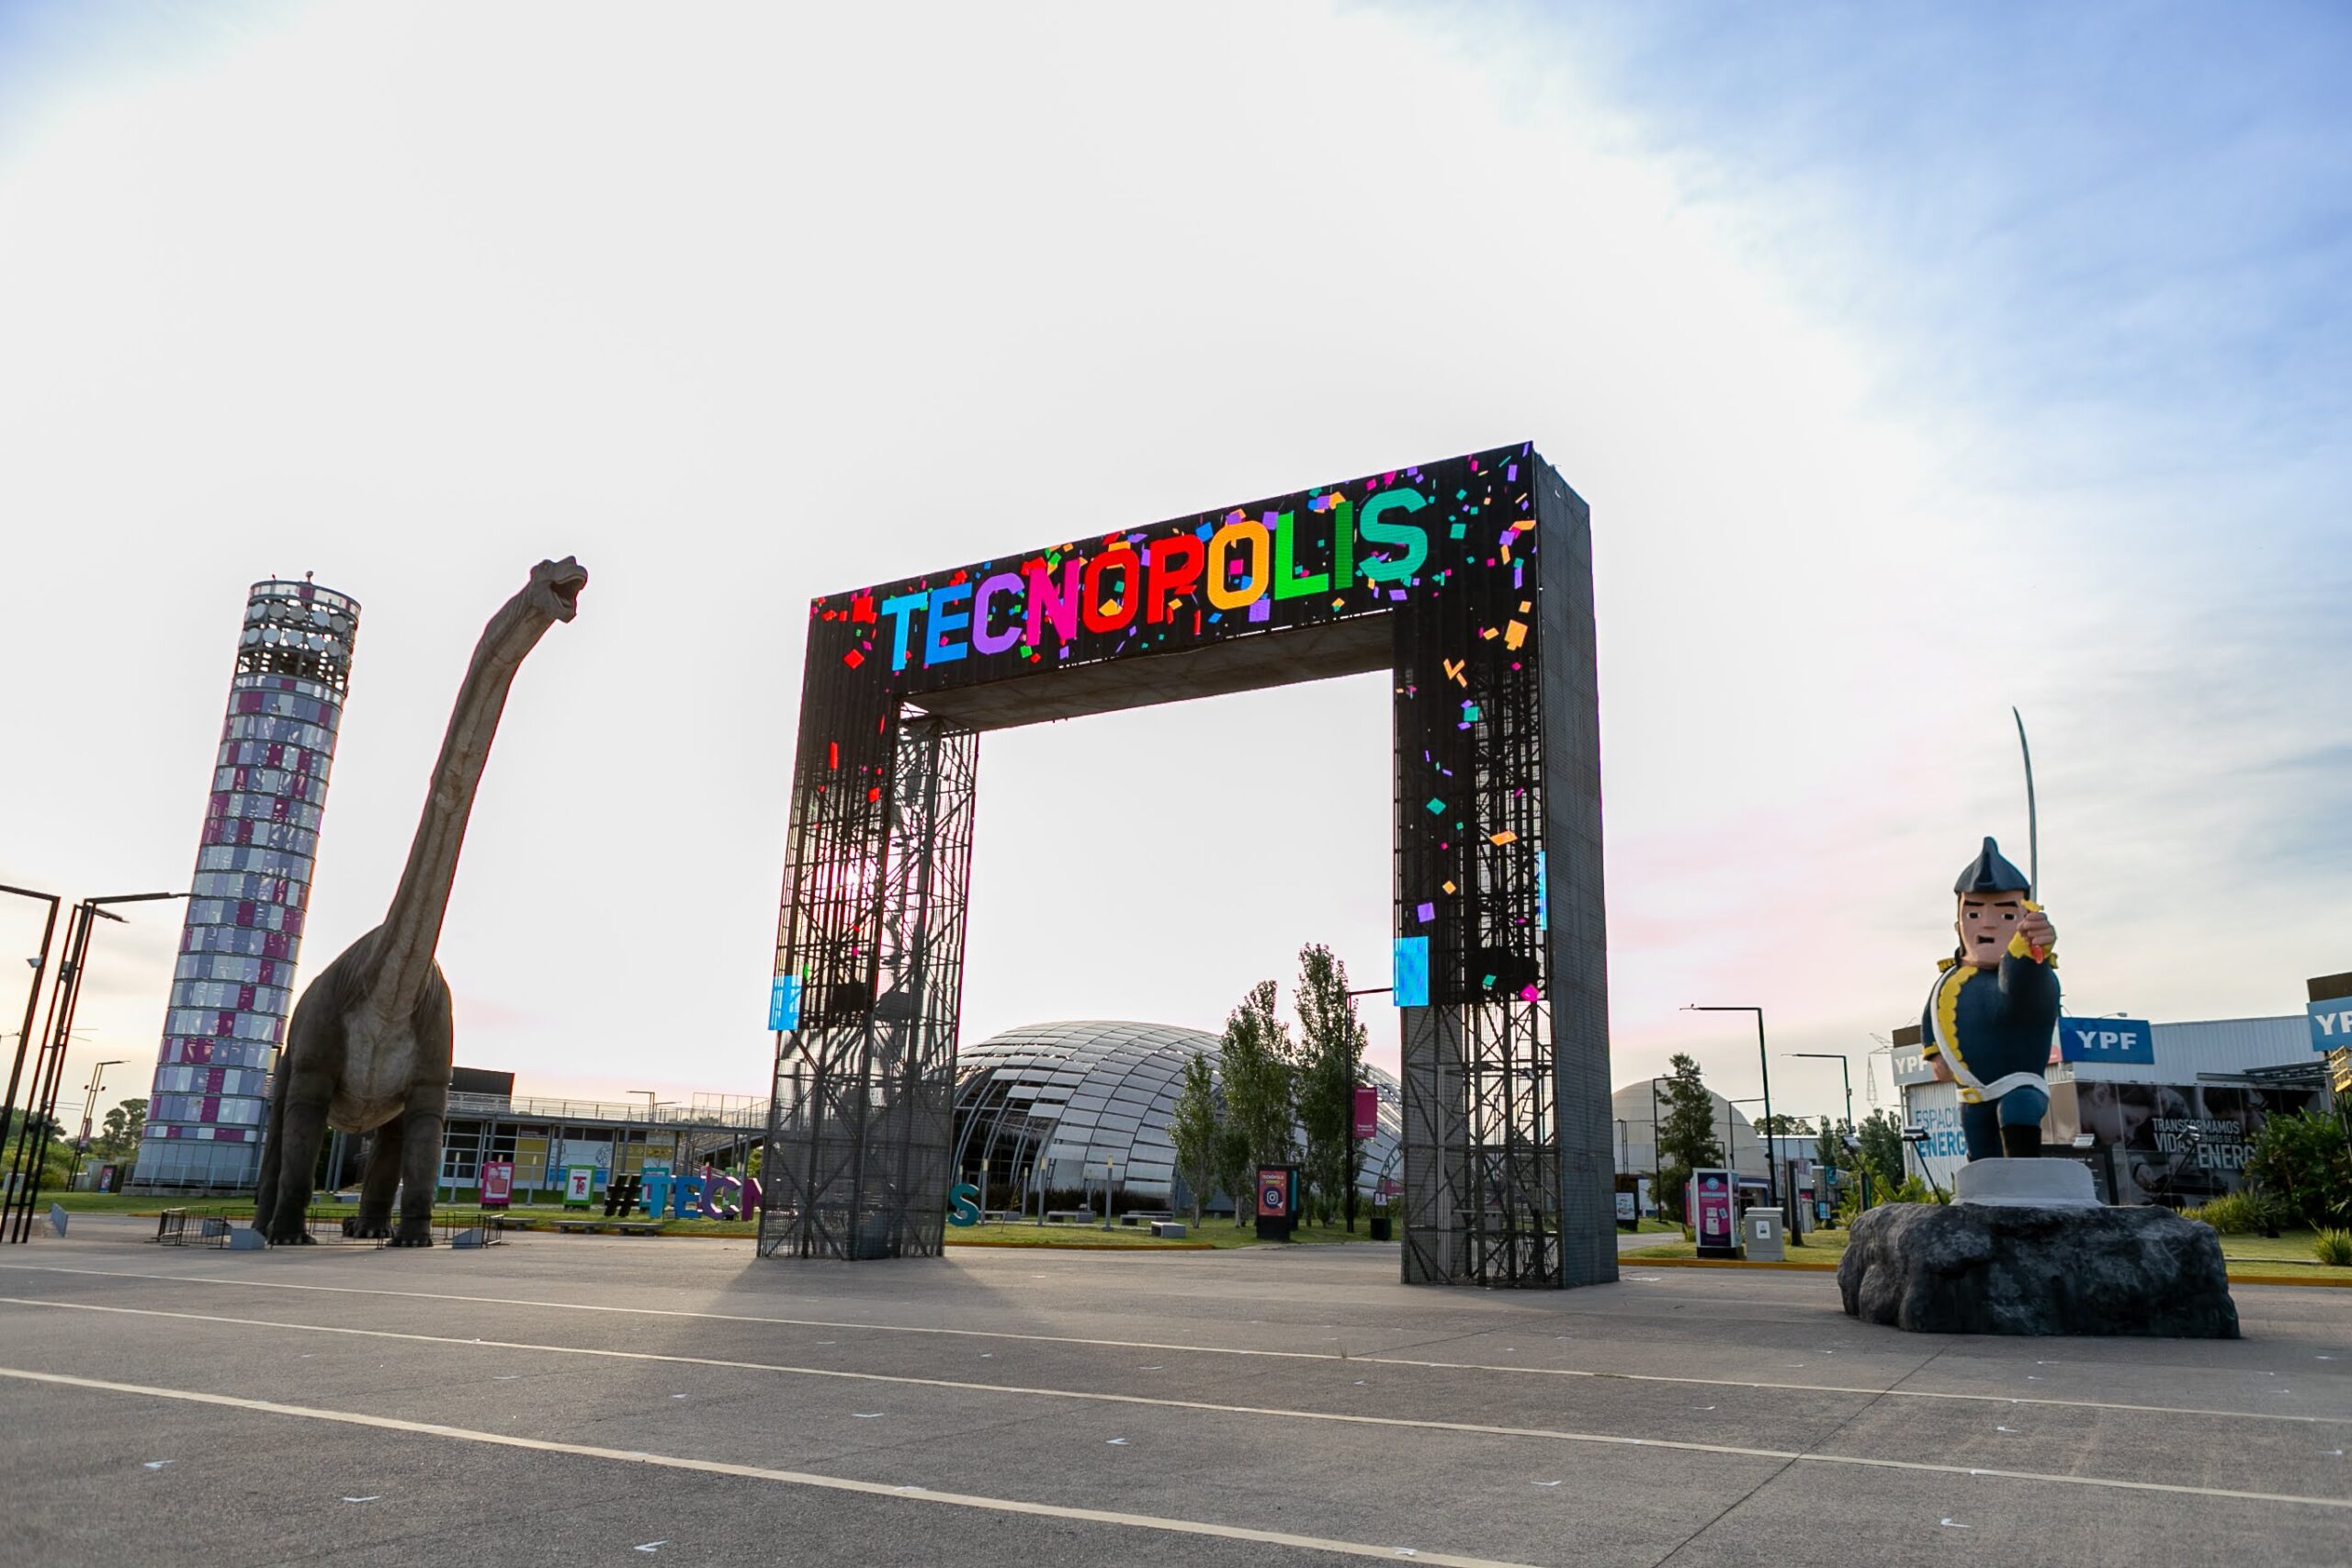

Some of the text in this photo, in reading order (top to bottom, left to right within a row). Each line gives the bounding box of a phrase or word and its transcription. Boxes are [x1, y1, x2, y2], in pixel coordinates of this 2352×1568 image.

[2315, 1010, 2352, 1035] YP
[2075, 1031, 2137, 1049] YPF
[1915, 1107, 1962, 1129] ESPACI
[1918, 1131, 1968, 1157] ENERG
